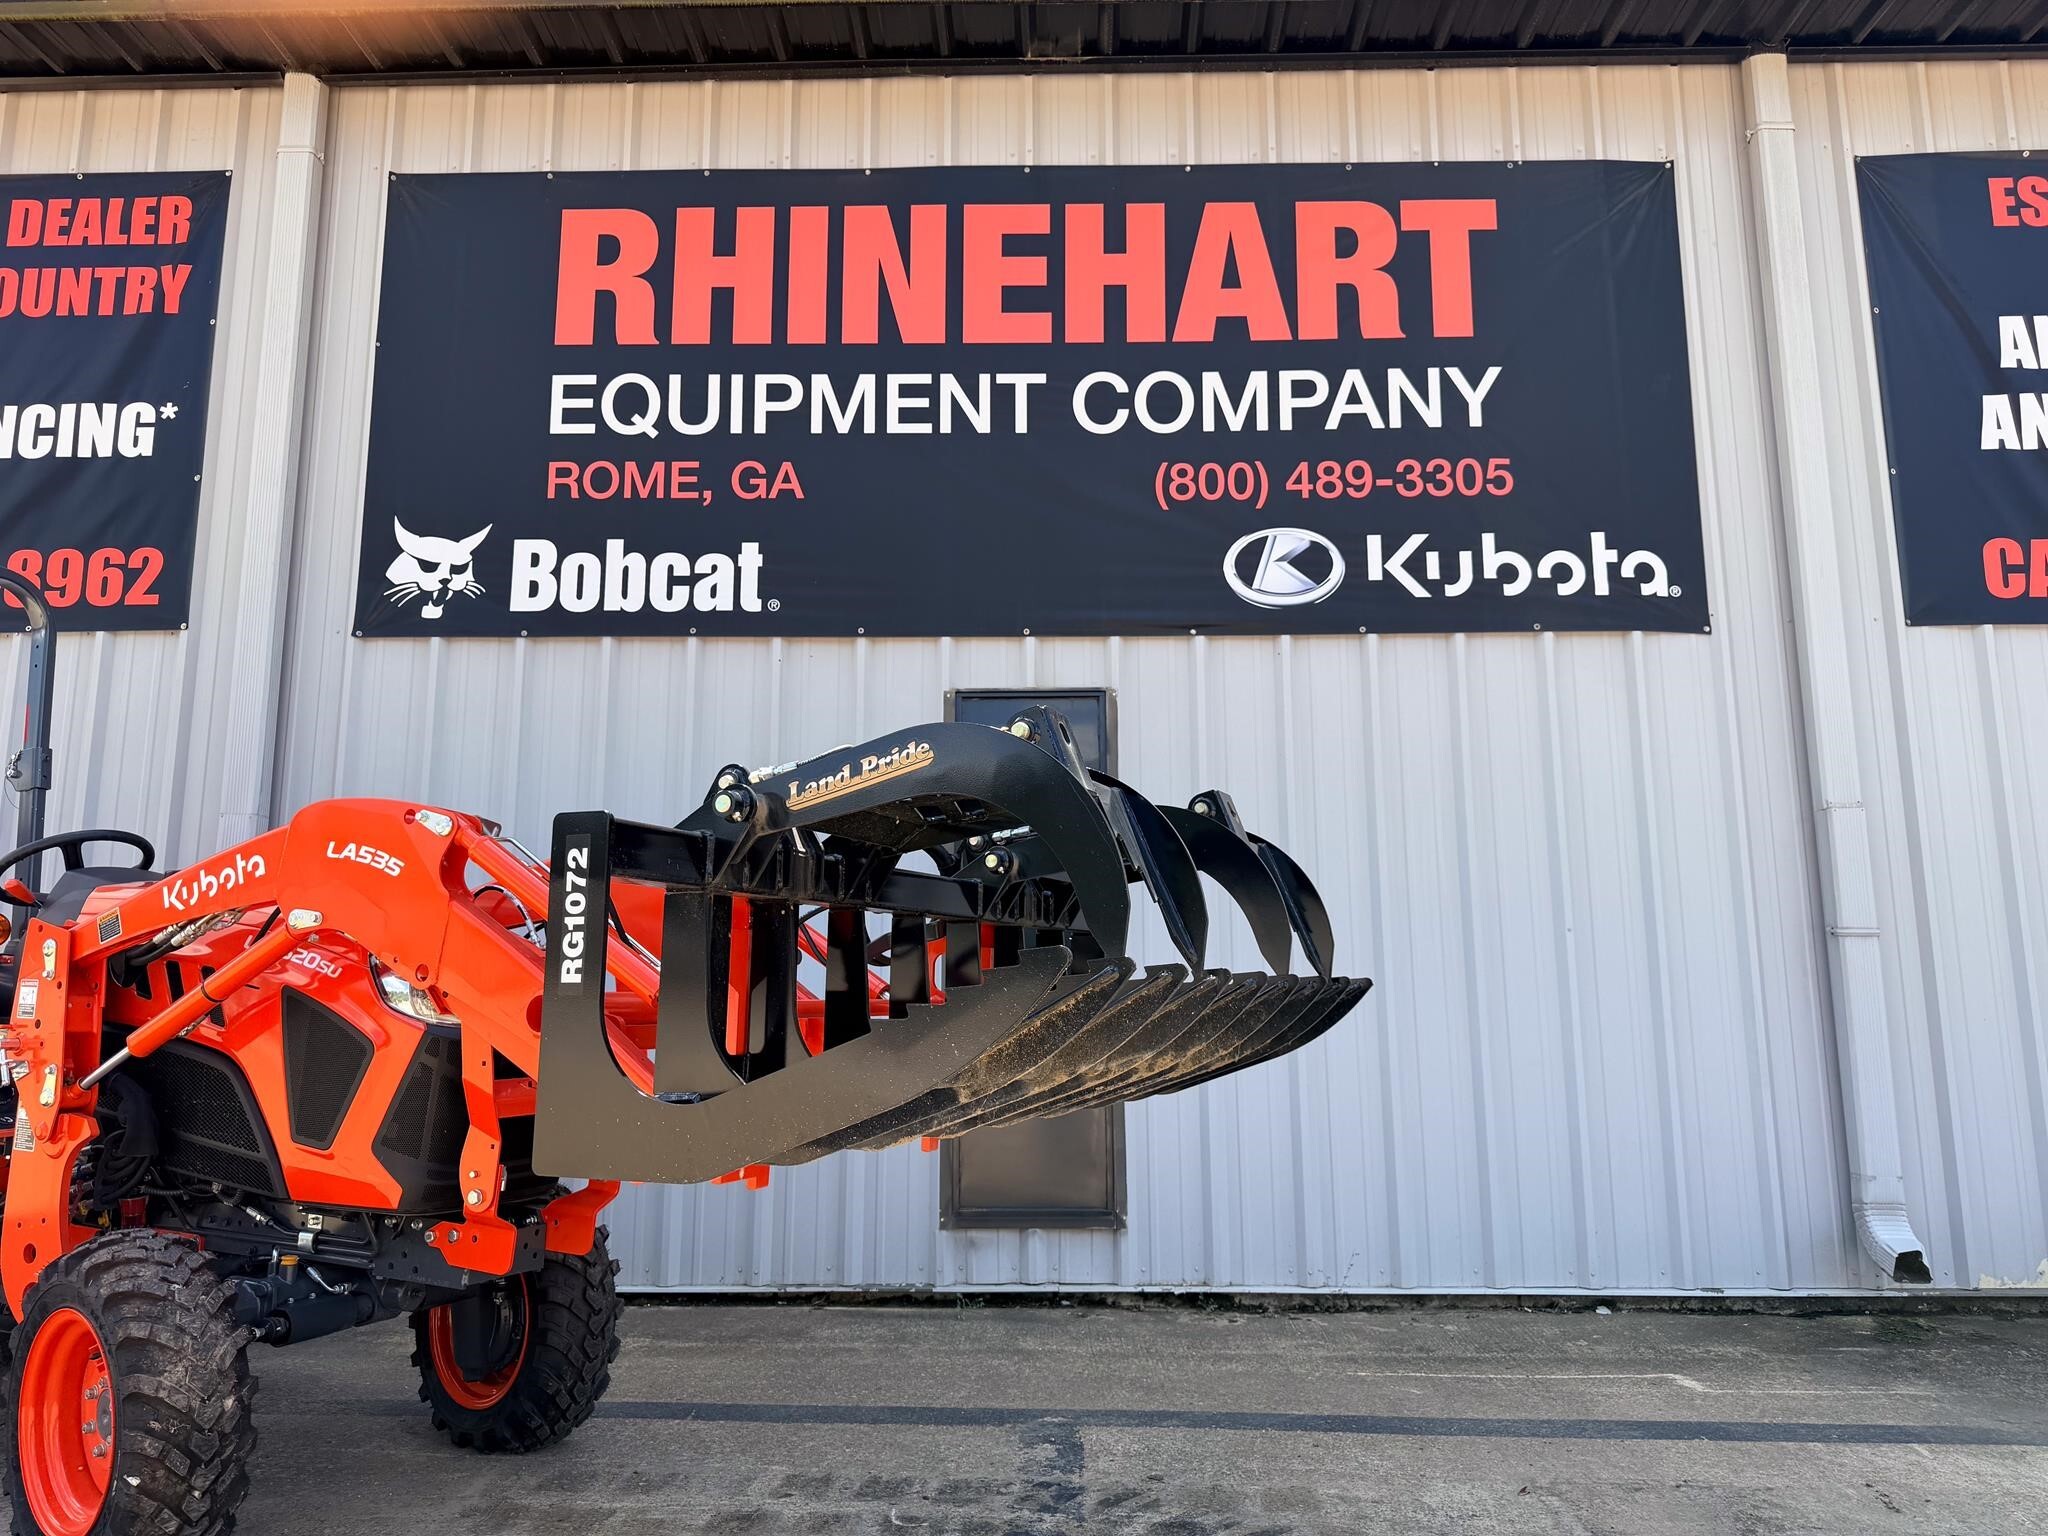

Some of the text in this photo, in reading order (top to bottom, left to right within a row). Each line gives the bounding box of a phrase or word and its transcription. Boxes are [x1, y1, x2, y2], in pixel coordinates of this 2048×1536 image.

[7, 196, 193, 247] DEALER
[554, 199, 1498, 346] RHINEHART
[1998, 315, 2048, 370] A
[549, 366, 1503, 439] EQUIPMENT COMPANY
[547, 461, 804, 506] ROME, GA
[1155, 457, 1514, 510] (800) 489-3305
[787, 741, 935, 803] Land Pride
[162, 853, 267, 911] Kubota
[326, 841, 405, 877] LA535
[560, 847, 589, 984] RG1072
